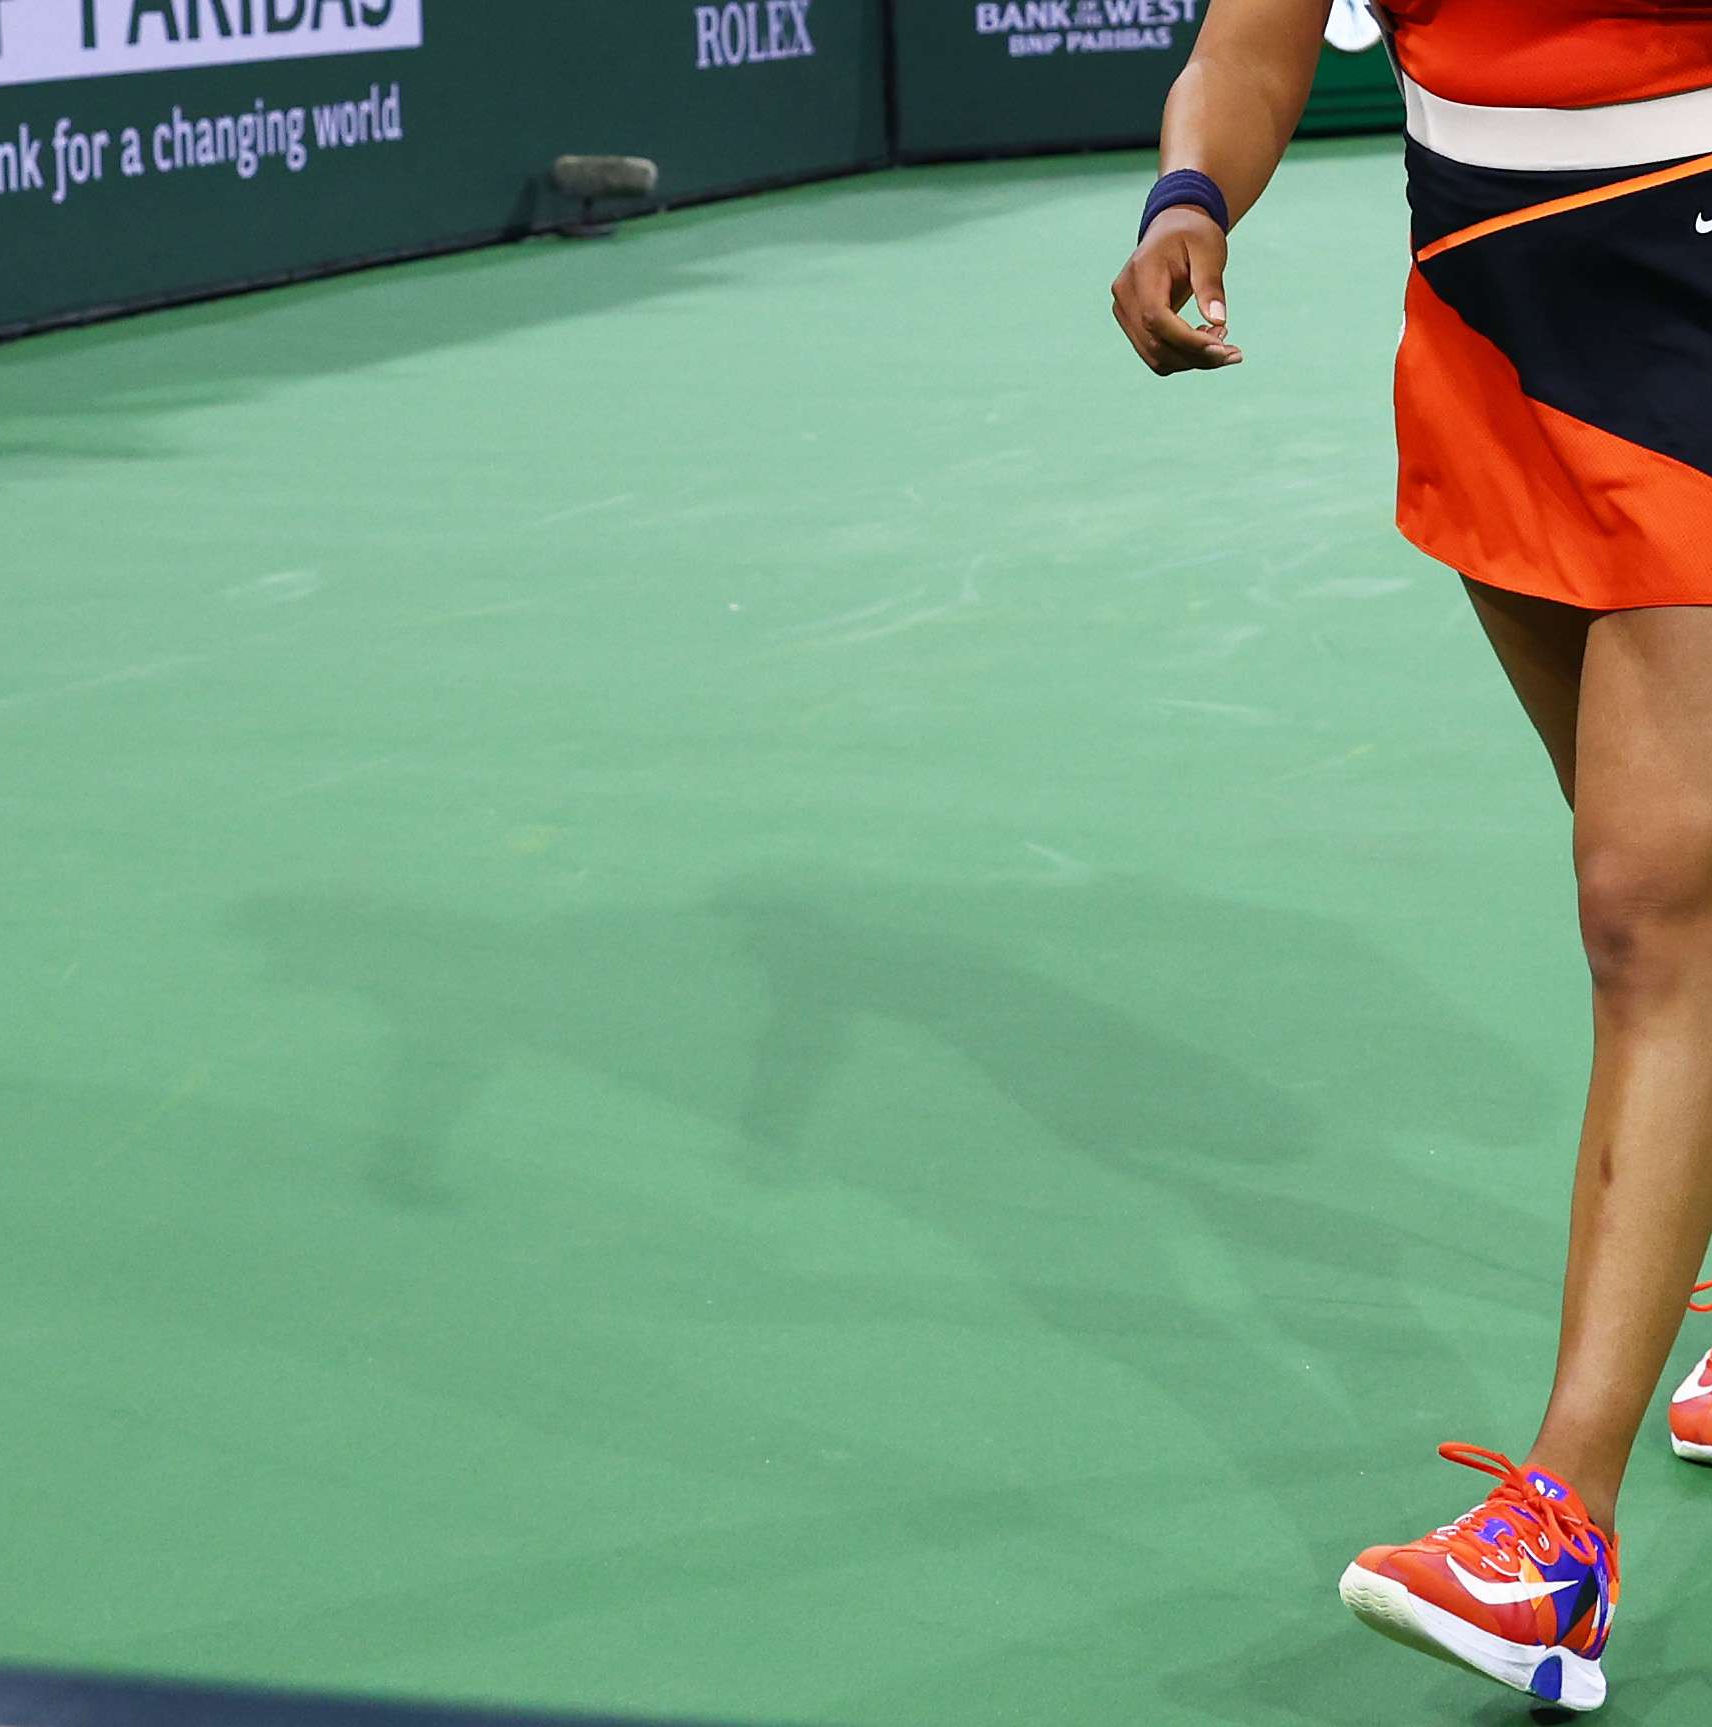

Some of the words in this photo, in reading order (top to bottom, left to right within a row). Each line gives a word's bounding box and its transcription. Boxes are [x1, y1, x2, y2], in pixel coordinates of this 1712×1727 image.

[1007, 32, 1063, 57] BNP
[1065, 25, 1173, 54] PARIBAS
[51, 117, 111, 205] for
[120, 127, 145, 177] a
[153, 97, 307, 179] changing
[312, 80, 403, 149] world
